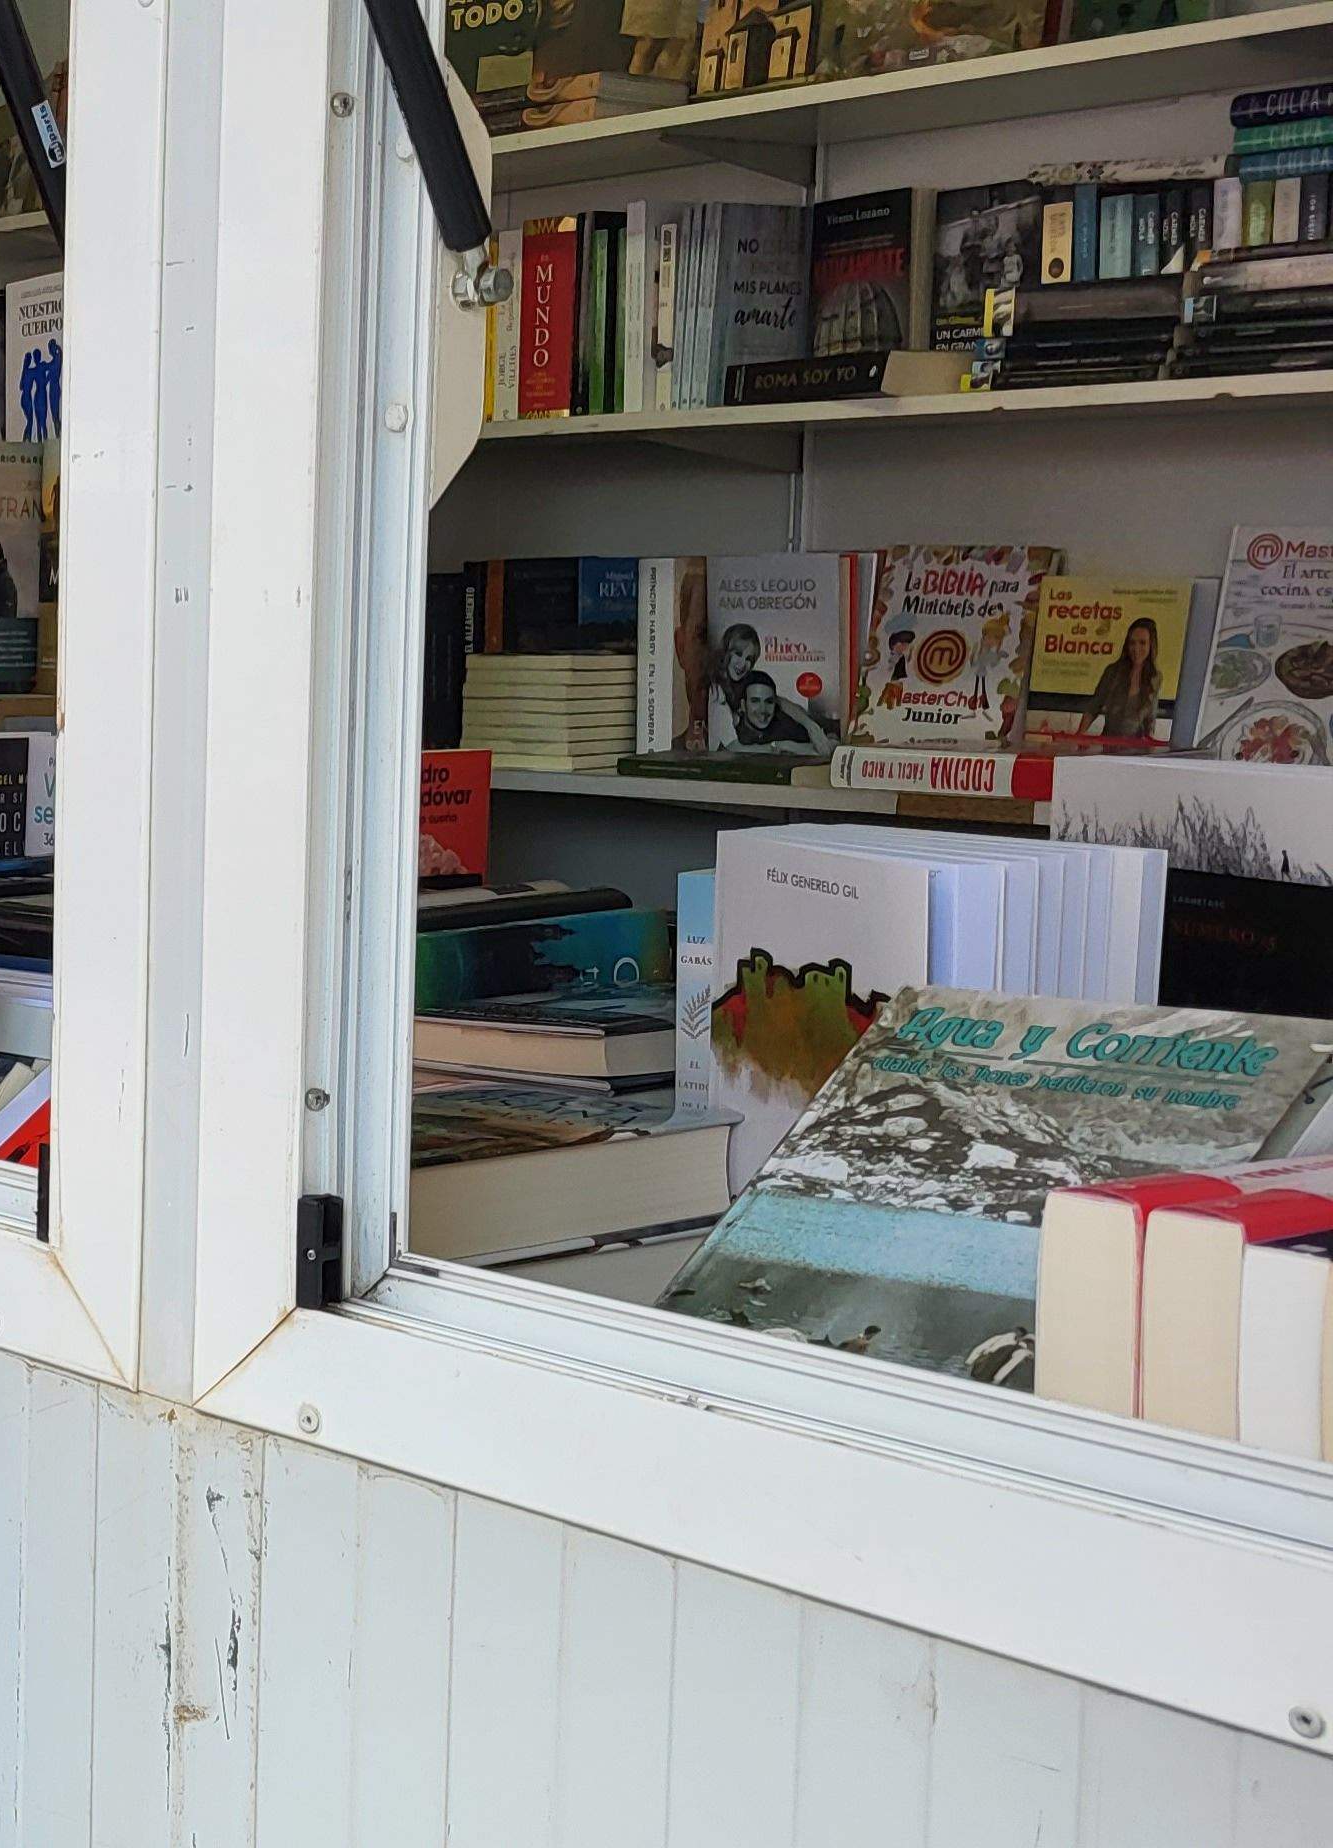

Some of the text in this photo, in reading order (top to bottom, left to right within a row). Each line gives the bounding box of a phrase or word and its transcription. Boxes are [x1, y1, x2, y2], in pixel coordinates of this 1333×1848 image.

[451, 0, 523, 31] TODO
[1267, 88, 1319, 116] CULPA
[856, 207, 890, 221] Lozano
[737, 239, 759, 253] NO
[734, 281, 802, 295] MIS PLANES
[533, 263, 554, 367] MUNDO
[735, 297, 797, 330] amarte
[936, 332, 952, 342] UN
[754, 364, 857, 392] ROMA SOY YO
[719, 579, 816, 593] ALESS LEQUIO
[905, 570, 1020, 597] La BIBLIA para
[1261, 583, 1310, 596] cocina
[718, 593, 817, 610] ANA OBREGÓN
[1049, 588, 1073, 601] Las
[648, 566, 658, 656] PRÍNCIPE HARRY
[902, 595, 997, 618] Minichefs de
[1047, 602, 1123, 622] recetas
[1071, 624, 1088, 636] de
[1044, 634, 1114, 656] Blanca
[647, 663, 656, 743] EN LA SOMBRA
[902, 707, 961, 725] Junior
[421, 763, 450, 784] dro
[888, 761, 895, 778] Y
[898, 760, 924, 784] FÁCIL
[931, 757, 996, 792] COCINA
[12, 792, 23, 804] SI
[421, 789, 472, 807] dóvar
[428, 812, 457, 823] sueño
[766, 868, 860, 900] FÉLIX GENERELO GIL
[686, 934, 706, 946] LUZ
[680, 954, 714, 967] GABÁS
[897, 1005, 1279, 1078] Agua y Corriente
[689, 1060, 701, 1070] EL
[941, 1061, 965, 1079] los
[1032, 1073, 1126, 1099] perdieron
[1134, 1083, 1158, 1100] su
[1162, 1086, 1241, 1112] nombre
